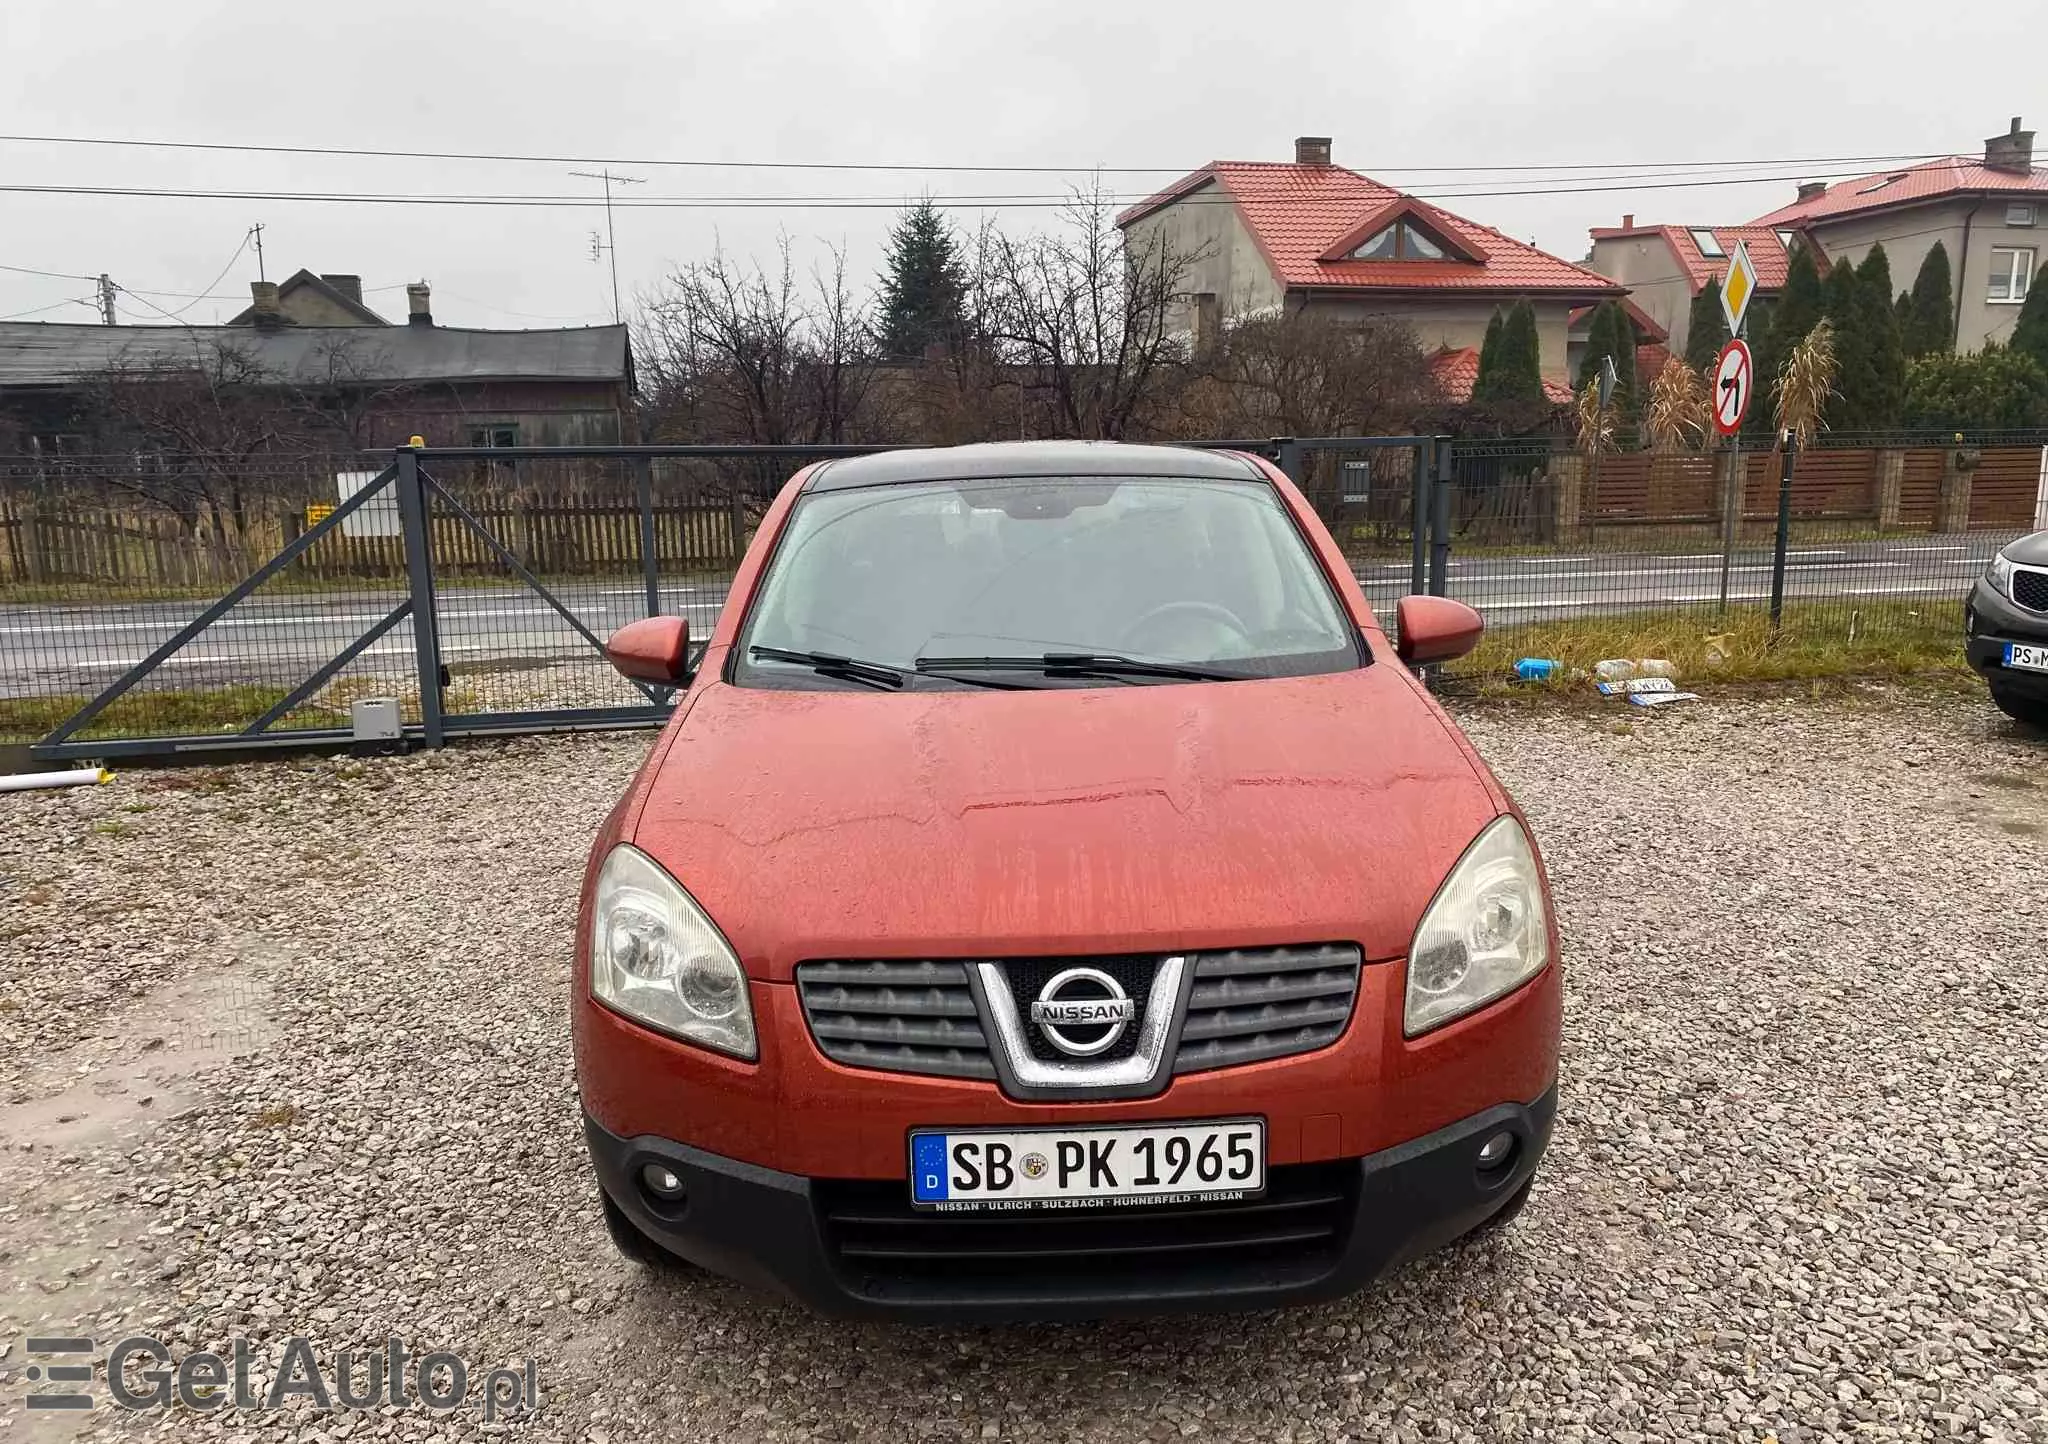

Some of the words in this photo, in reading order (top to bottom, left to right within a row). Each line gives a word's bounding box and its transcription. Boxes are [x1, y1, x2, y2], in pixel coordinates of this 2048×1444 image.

[2013, 646, 2032, 664] PS
[1041, 1004, 1124, 1019] NISSAN
[952, 1142, 1014, 1192] SB
[1056, 1139, 1118, 1189] PK
[1133, 1132, 1254, 1187] 1965
[926, 1174, 938, 1189] D
[935, 1202, 980, 1212] NISSAN
[988, 1200, 1032, 1211] ULRICH
[1041, 1198, 1104, 1209] SULZBACH
[1200, 1191, 1243, 1202] NISSAN
